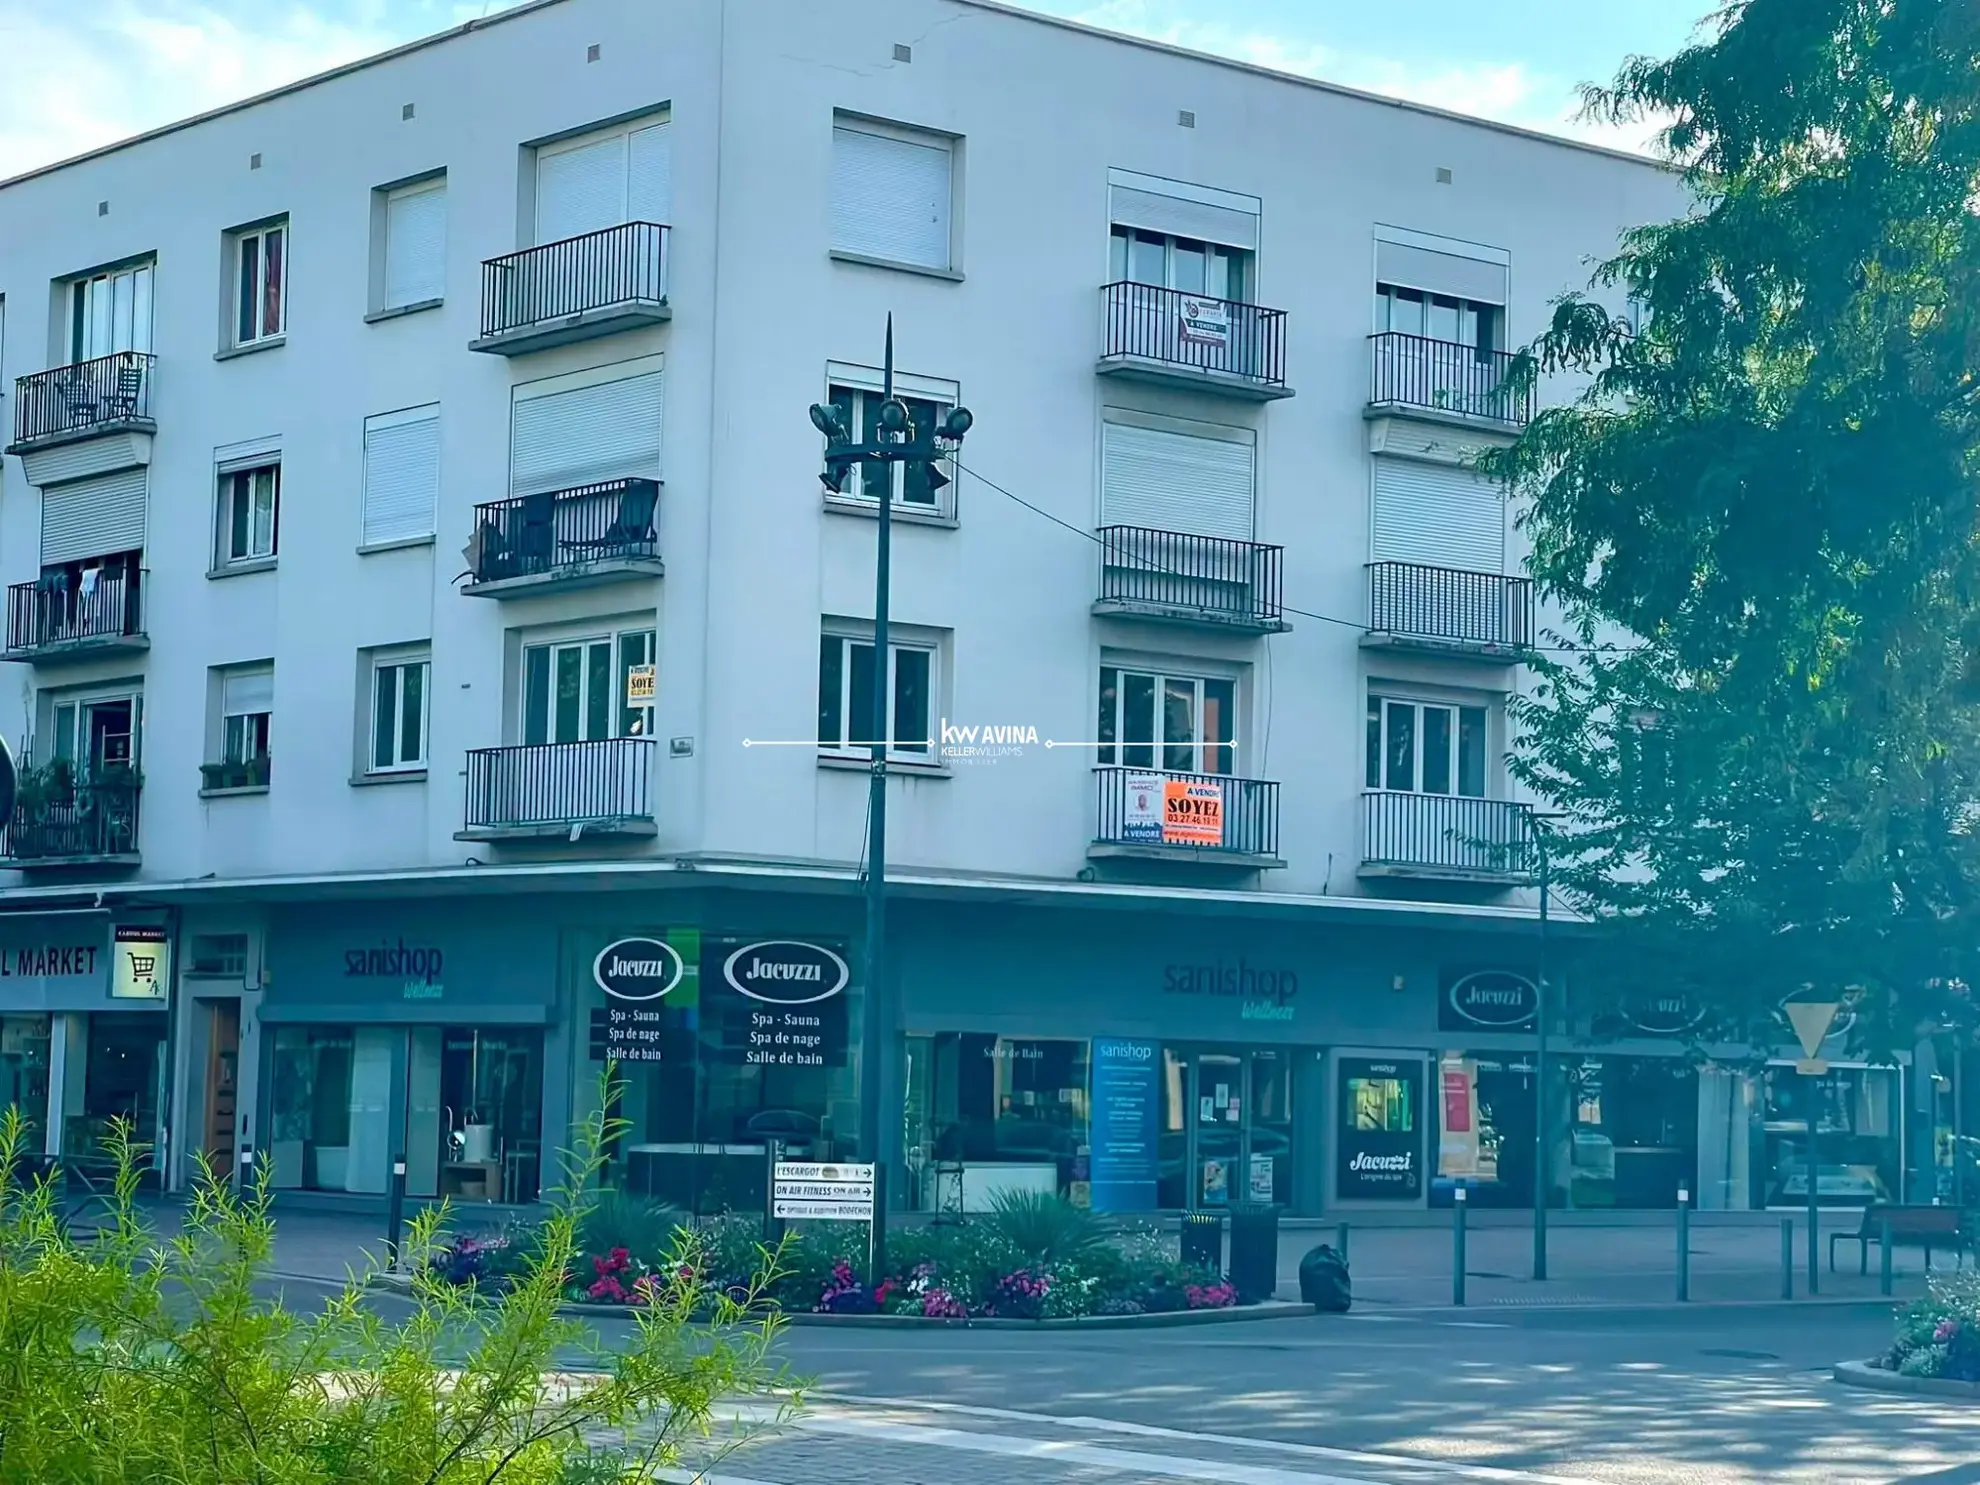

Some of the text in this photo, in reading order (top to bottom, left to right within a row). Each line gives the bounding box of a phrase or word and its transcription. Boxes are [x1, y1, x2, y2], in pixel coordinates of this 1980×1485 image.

[1167, 798, 1219, 817] SOYEZ
[17, 946, 97, 976] MARKET
[344, 936, 443, 985] sanishop
[608, 955, 663, 978] Jacuzzi
[746, 957, 822, 981] Jacuzzi
[1163, 956, 1298, 1007] sanishop
[1466, 986, 1523, 1005] Jacuzzi
[610, 1009, 627, 1022] Spa
[633, 1009, 660, 1022] Sauna
[752, 1012, 773, 1028] Spa
[784, 1014, 820, 1027] Sauna
[609, 1027, 660, 1042] Spa de nage
[750, 1031, 821, 1048] Spa de nage
[606, 1047, 662, 1061] Salle de bain
[746, 1051, 823, 1066] Salle de bain
[1101, 1043, 1152, 1060] sanishop
[1349, 1151, 1412, 1171] Jacuzzi
[776, 1185, 788, 1195] ON
[789, 1185, 803, 1195] AIR
[803, 1186, 832, 1196] FITNESS
